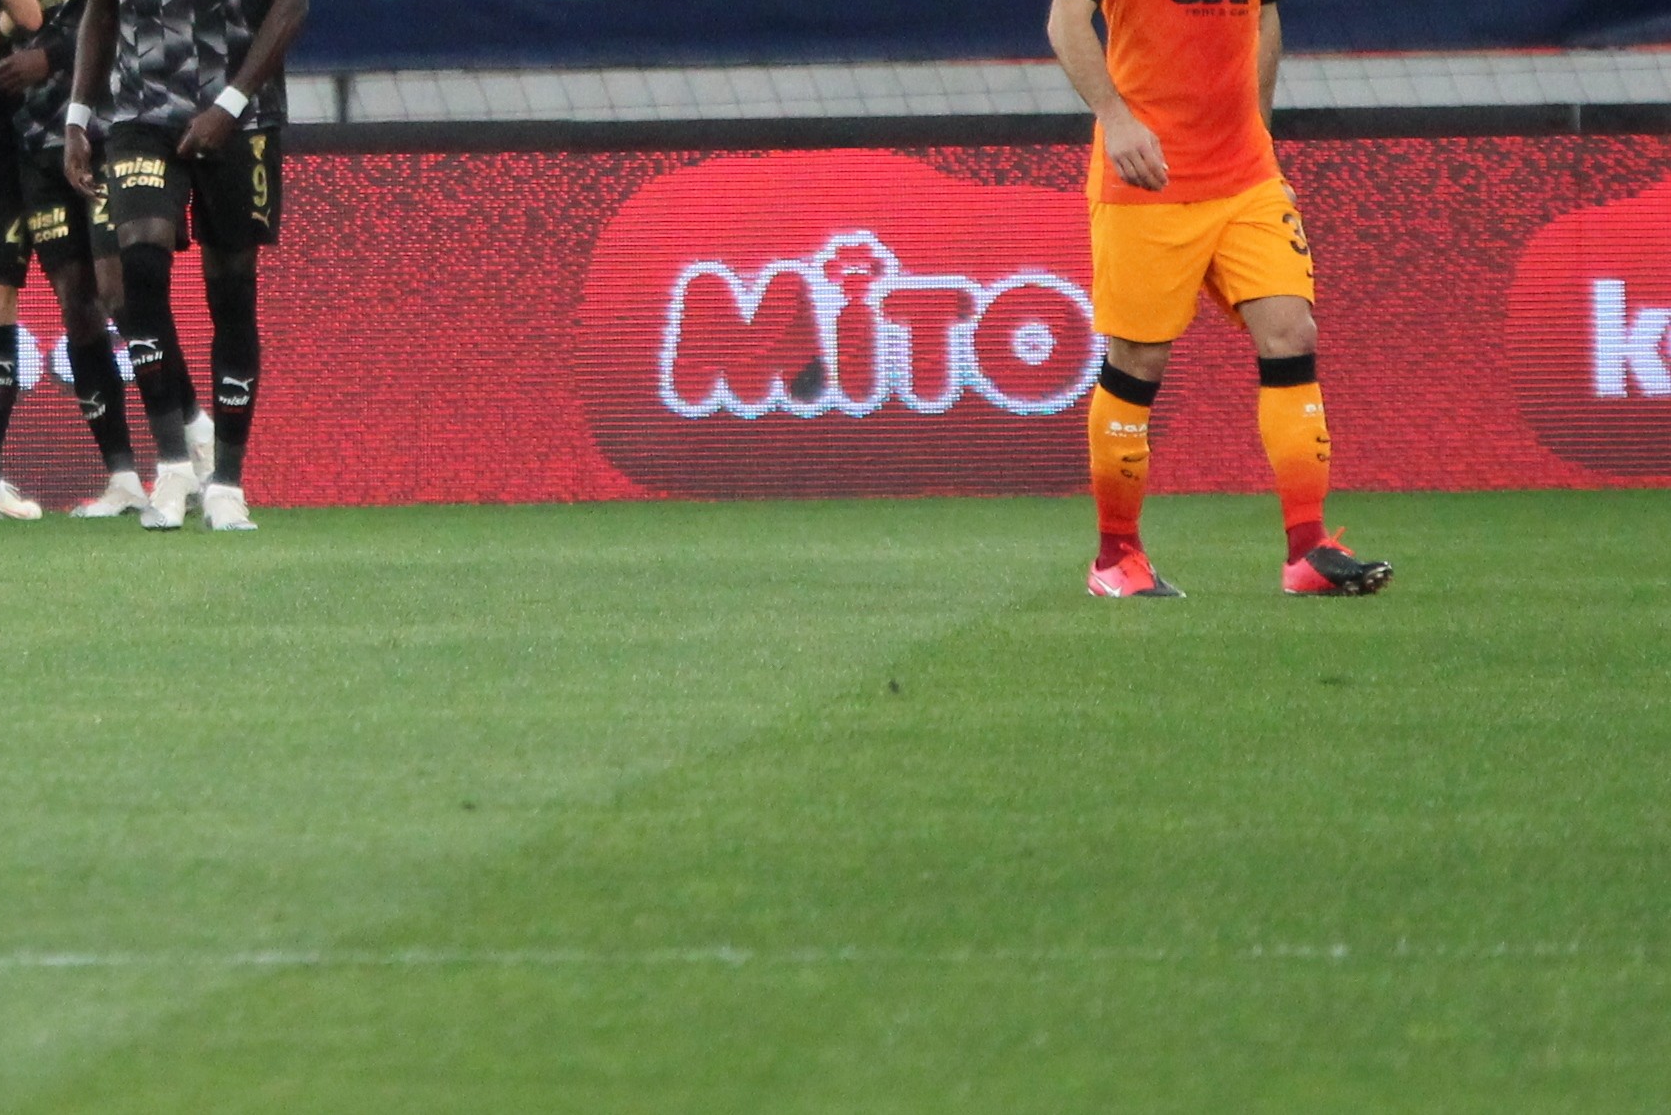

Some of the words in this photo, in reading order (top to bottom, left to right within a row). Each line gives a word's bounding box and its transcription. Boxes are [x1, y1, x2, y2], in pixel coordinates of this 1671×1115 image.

[113, 156, 166, 178] misli
[121, 175, 165, 189] .com
[252, 163, 268, 208] 9
